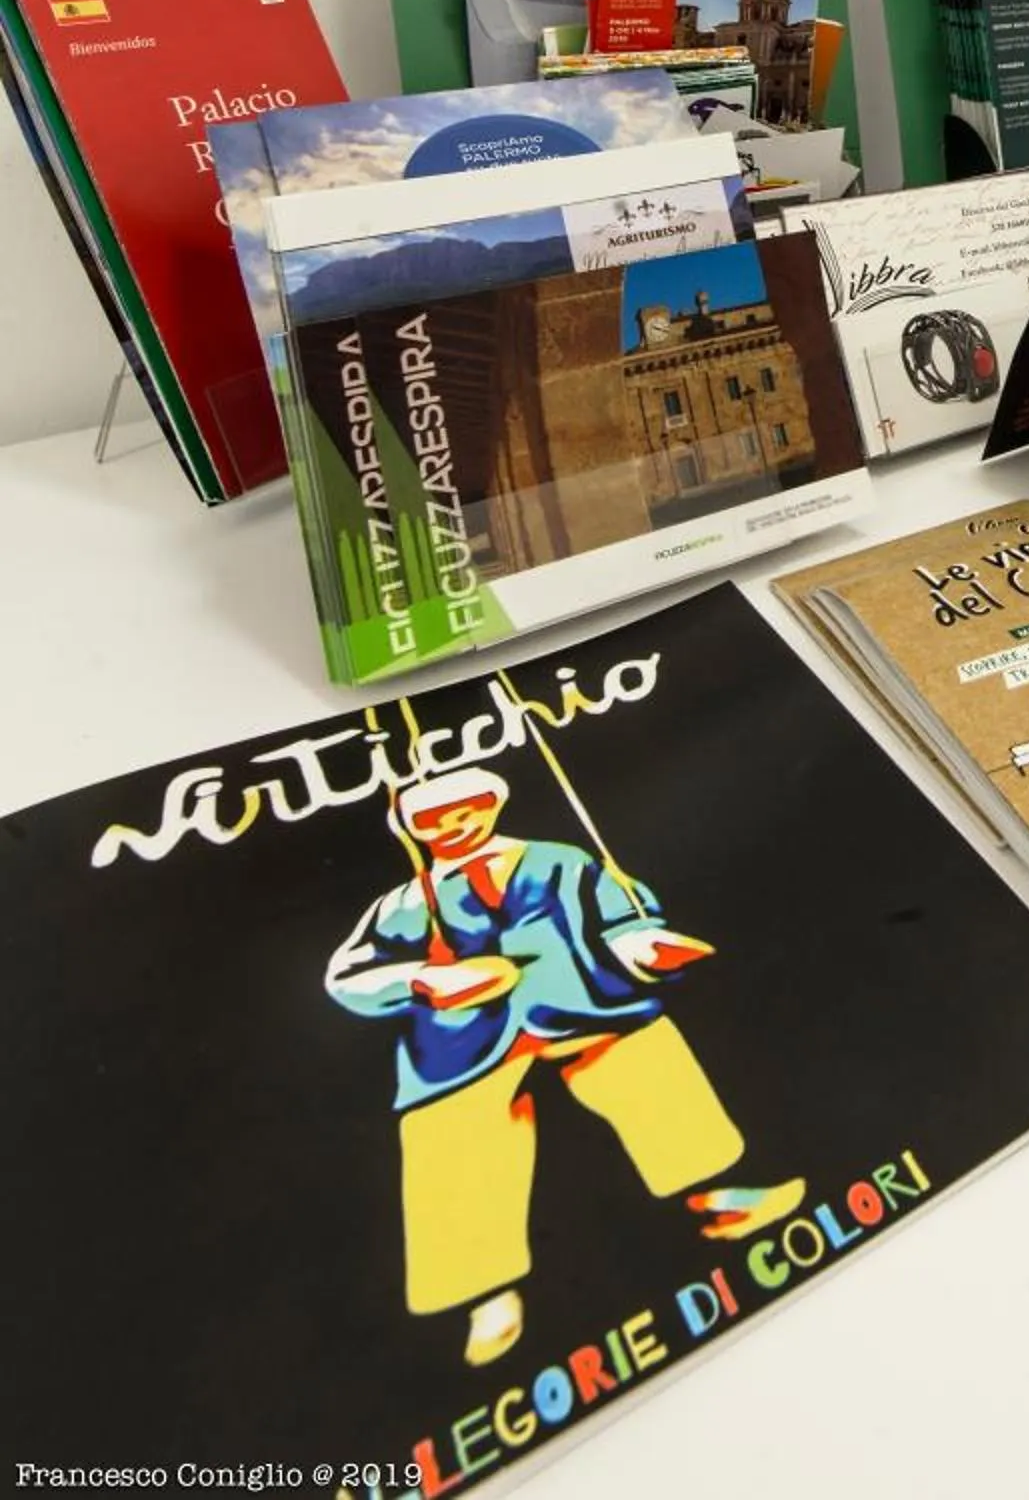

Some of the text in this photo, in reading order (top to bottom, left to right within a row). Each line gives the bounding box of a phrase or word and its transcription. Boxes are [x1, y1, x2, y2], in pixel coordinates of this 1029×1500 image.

[69, 34, 157, 57] Bienvenidos
[167, 82, 297, 129] Palacio
[462, 145, 541, 164] PALERMO
[606, 221, 697, 249] AGRITURISMO
[396, 312, 485, 635] FICUZZARESPIRA
[912, 564, 979, 591] Le
[930, 580, 1006, 628] del
[675, 1267, 739, 1337] DI
[747, 1148, 932, 1291] COLORI
